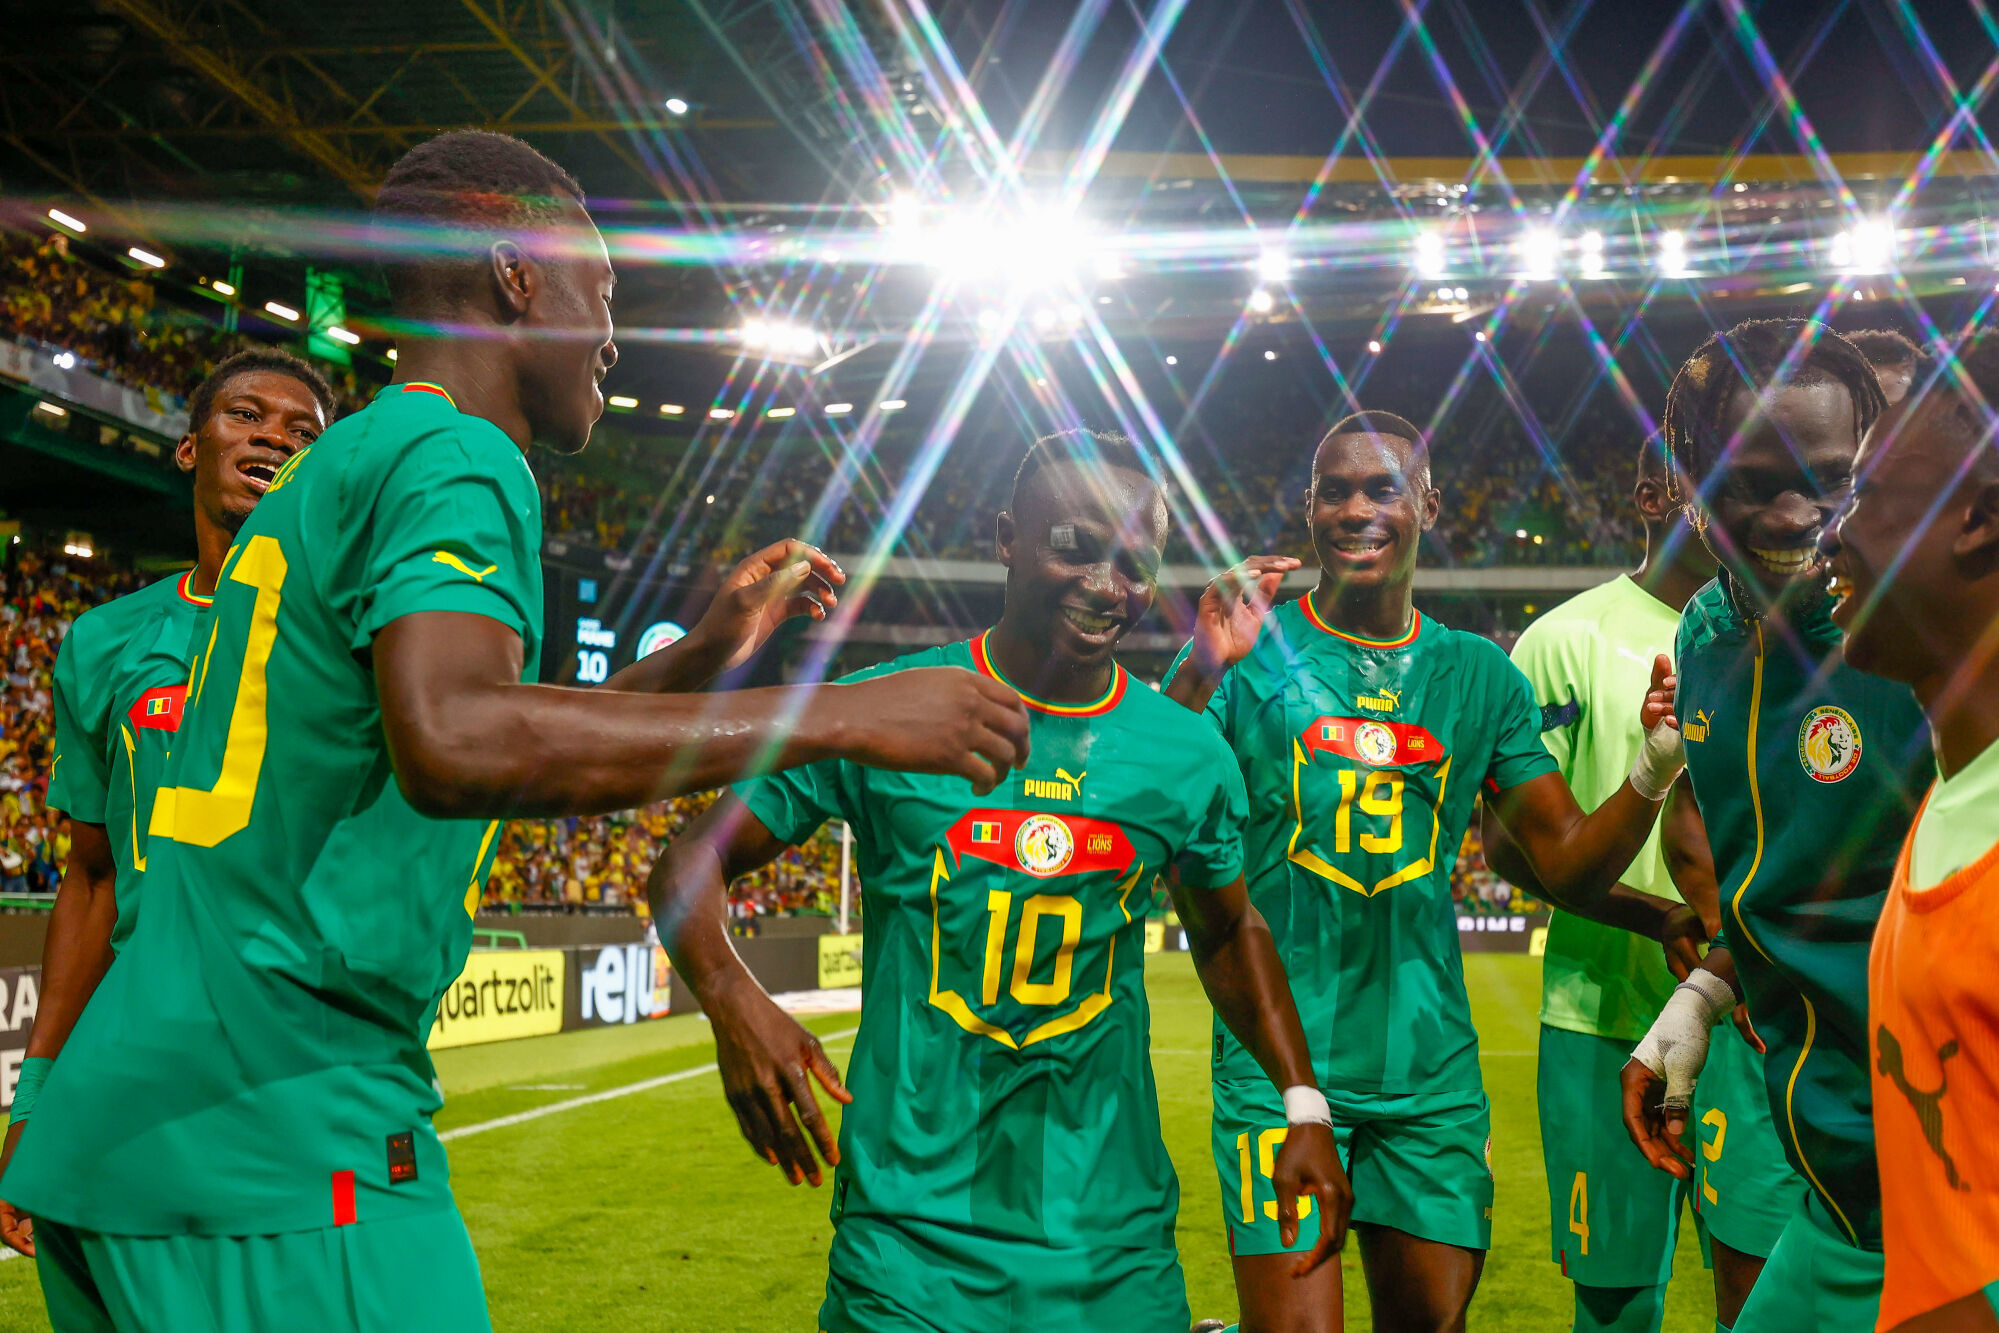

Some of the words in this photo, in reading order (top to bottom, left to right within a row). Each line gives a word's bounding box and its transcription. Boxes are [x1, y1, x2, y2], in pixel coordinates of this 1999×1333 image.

[577, 649, 608, 683] 10
[1356, 695, 1394, 712] PUMA
[1024, 778, 1072, 801] PUMA
[1335, 769, 1405, 854] 19
[1087, 837, 1112, 851] LIONS
[982, 888, 1083, 1006] 10
[1569, 1171, 1590, 1256] 4
